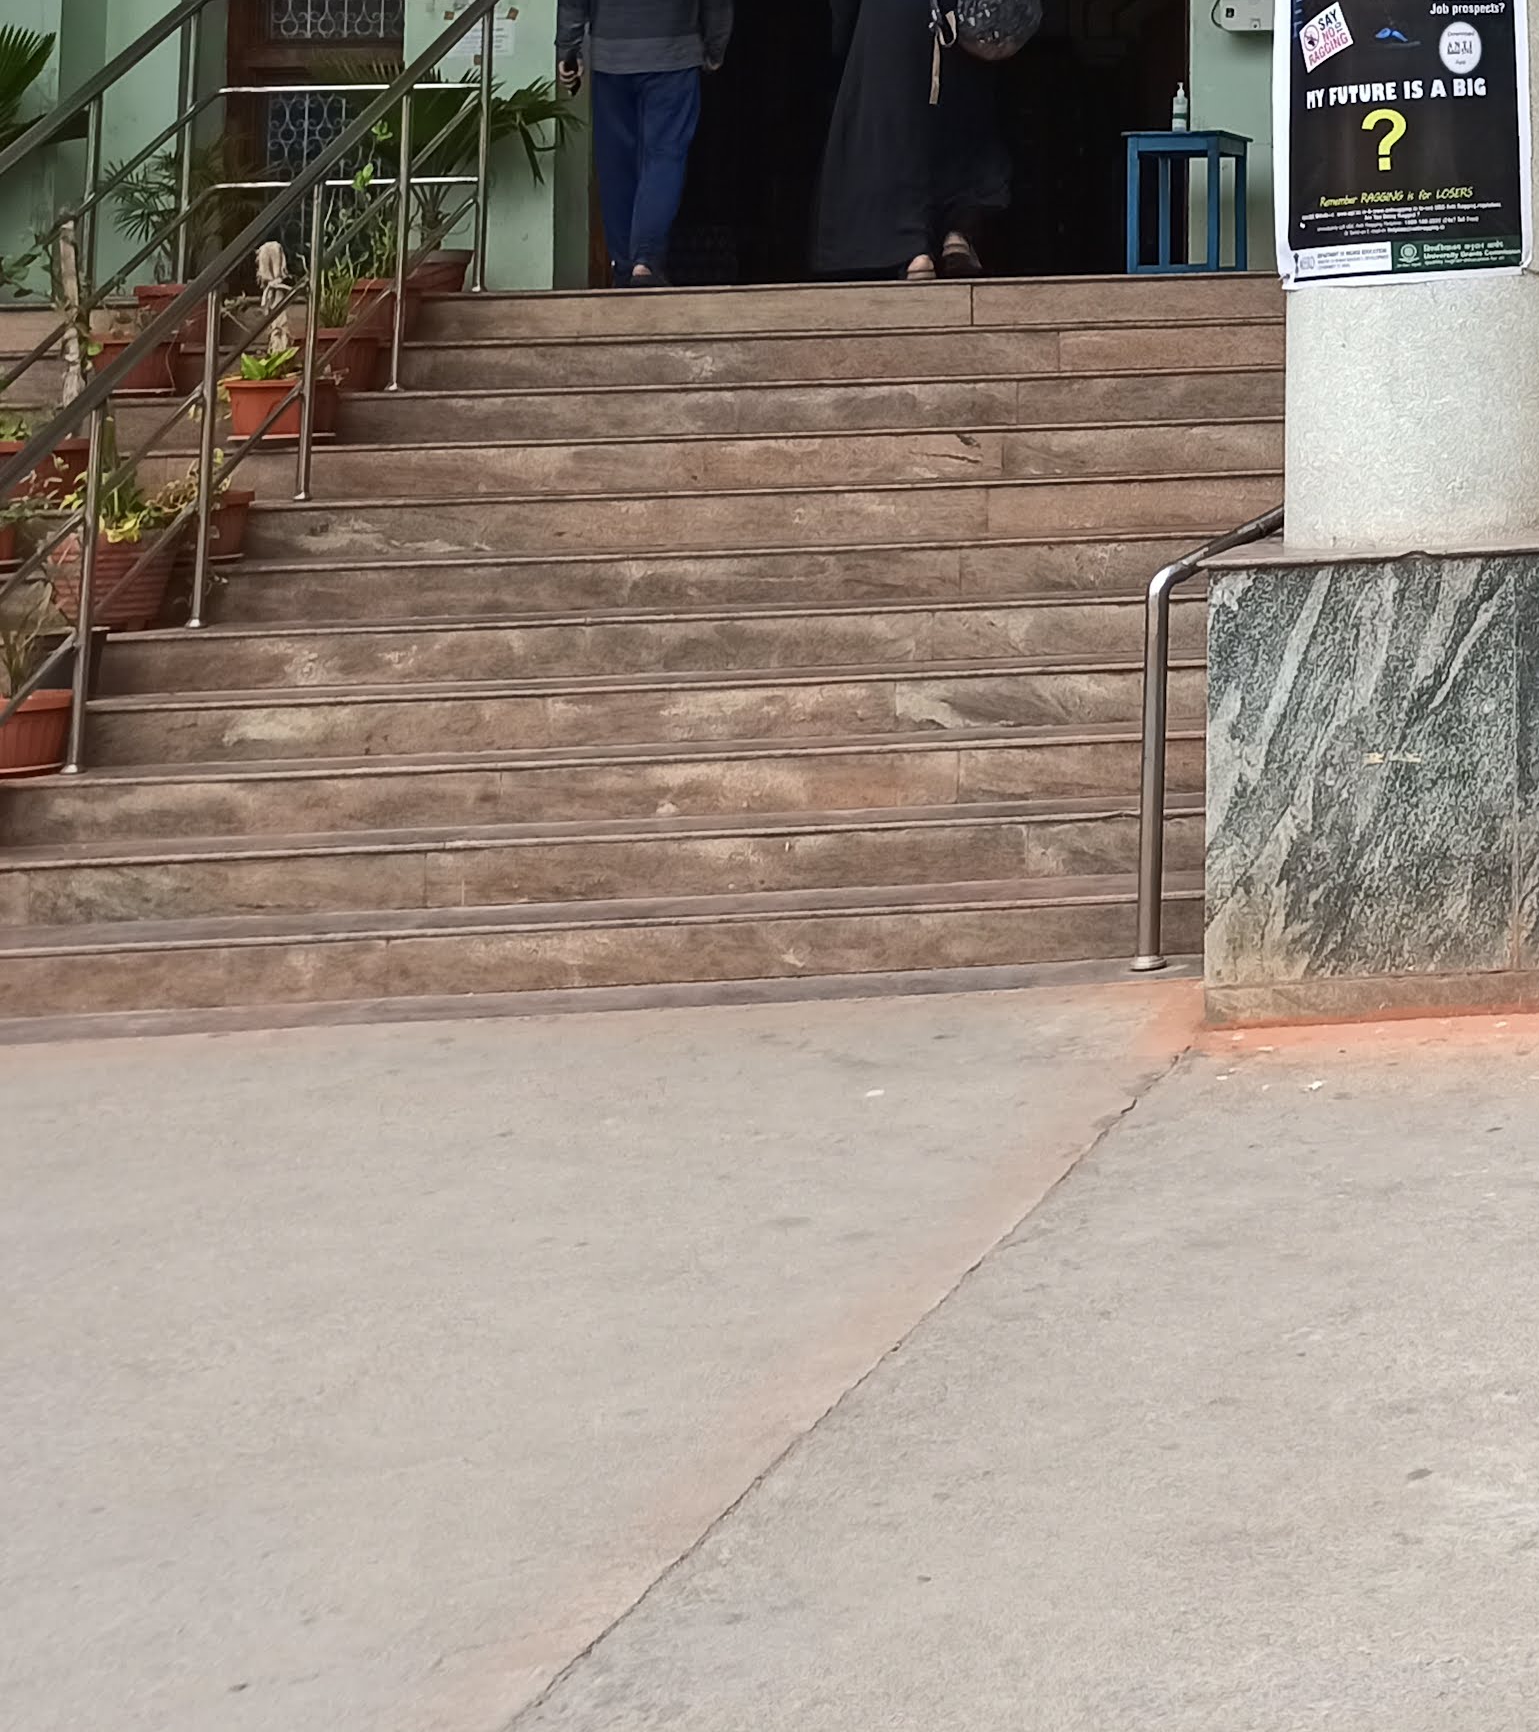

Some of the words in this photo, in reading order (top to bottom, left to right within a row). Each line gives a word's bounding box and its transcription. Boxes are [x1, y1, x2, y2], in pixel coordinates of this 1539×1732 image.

[1317, 8, 1339, 31] SAY
[1429, 3, 1450, 15] Job
[1452, 2, 1505, 16] prospects?
[1321, 26, 1336, 43] NO
[1306, 88, 1325, 110] MY
[1328, 81, 1398, 107] FUTURE
[1403, 79, 1424, 100] IS
[1430, 78, 1448, 98] A
[1452, 77, 1487, 97] BIG
[1361, 108, 1407, 171] ?
[1320, 194, 1358, 208] Remember
[1360, 189, 1404, 204] RAGGING
[1406, 191, 1415, 201] is
[1418, 189, 1432, 201] for
[1436, 186, 1474, 200] LOSERS
